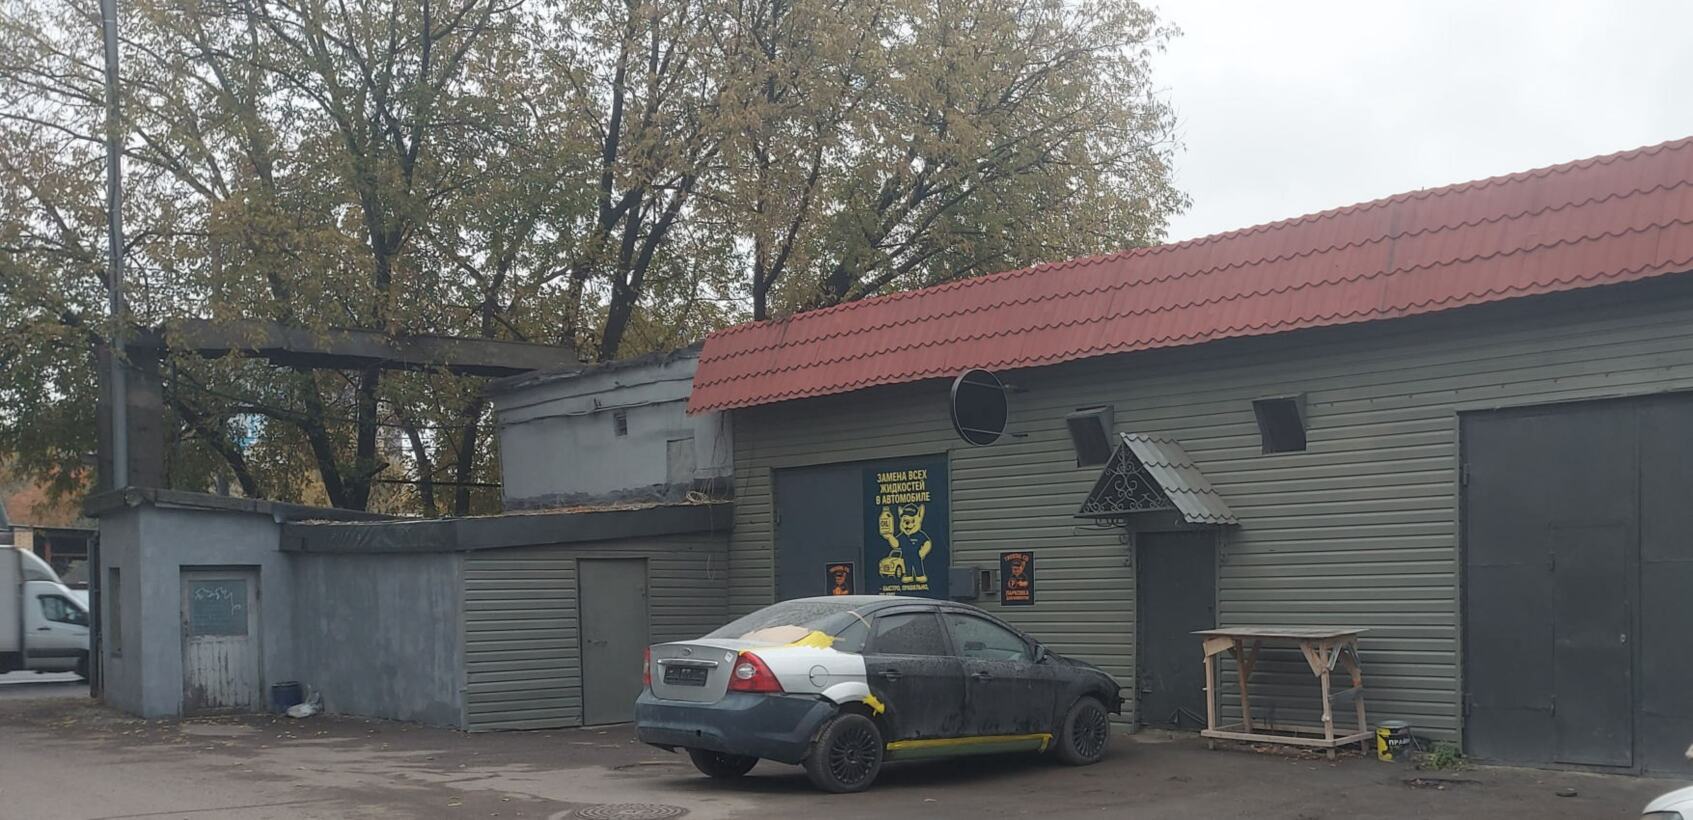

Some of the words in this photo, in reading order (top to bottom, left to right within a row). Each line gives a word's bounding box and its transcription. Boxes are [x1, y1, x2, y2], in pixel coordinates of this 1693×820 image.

[877, 472, 907, 483] ЗАМЕНА
[908, 469, 927, 480] ВСЕХ
[880, 481, 925, 493] ЖИДКОСТЕЙ
[875, 495, 881, 505] В
[882, 491, 930, 505] АВТОМОБИЛЕ
